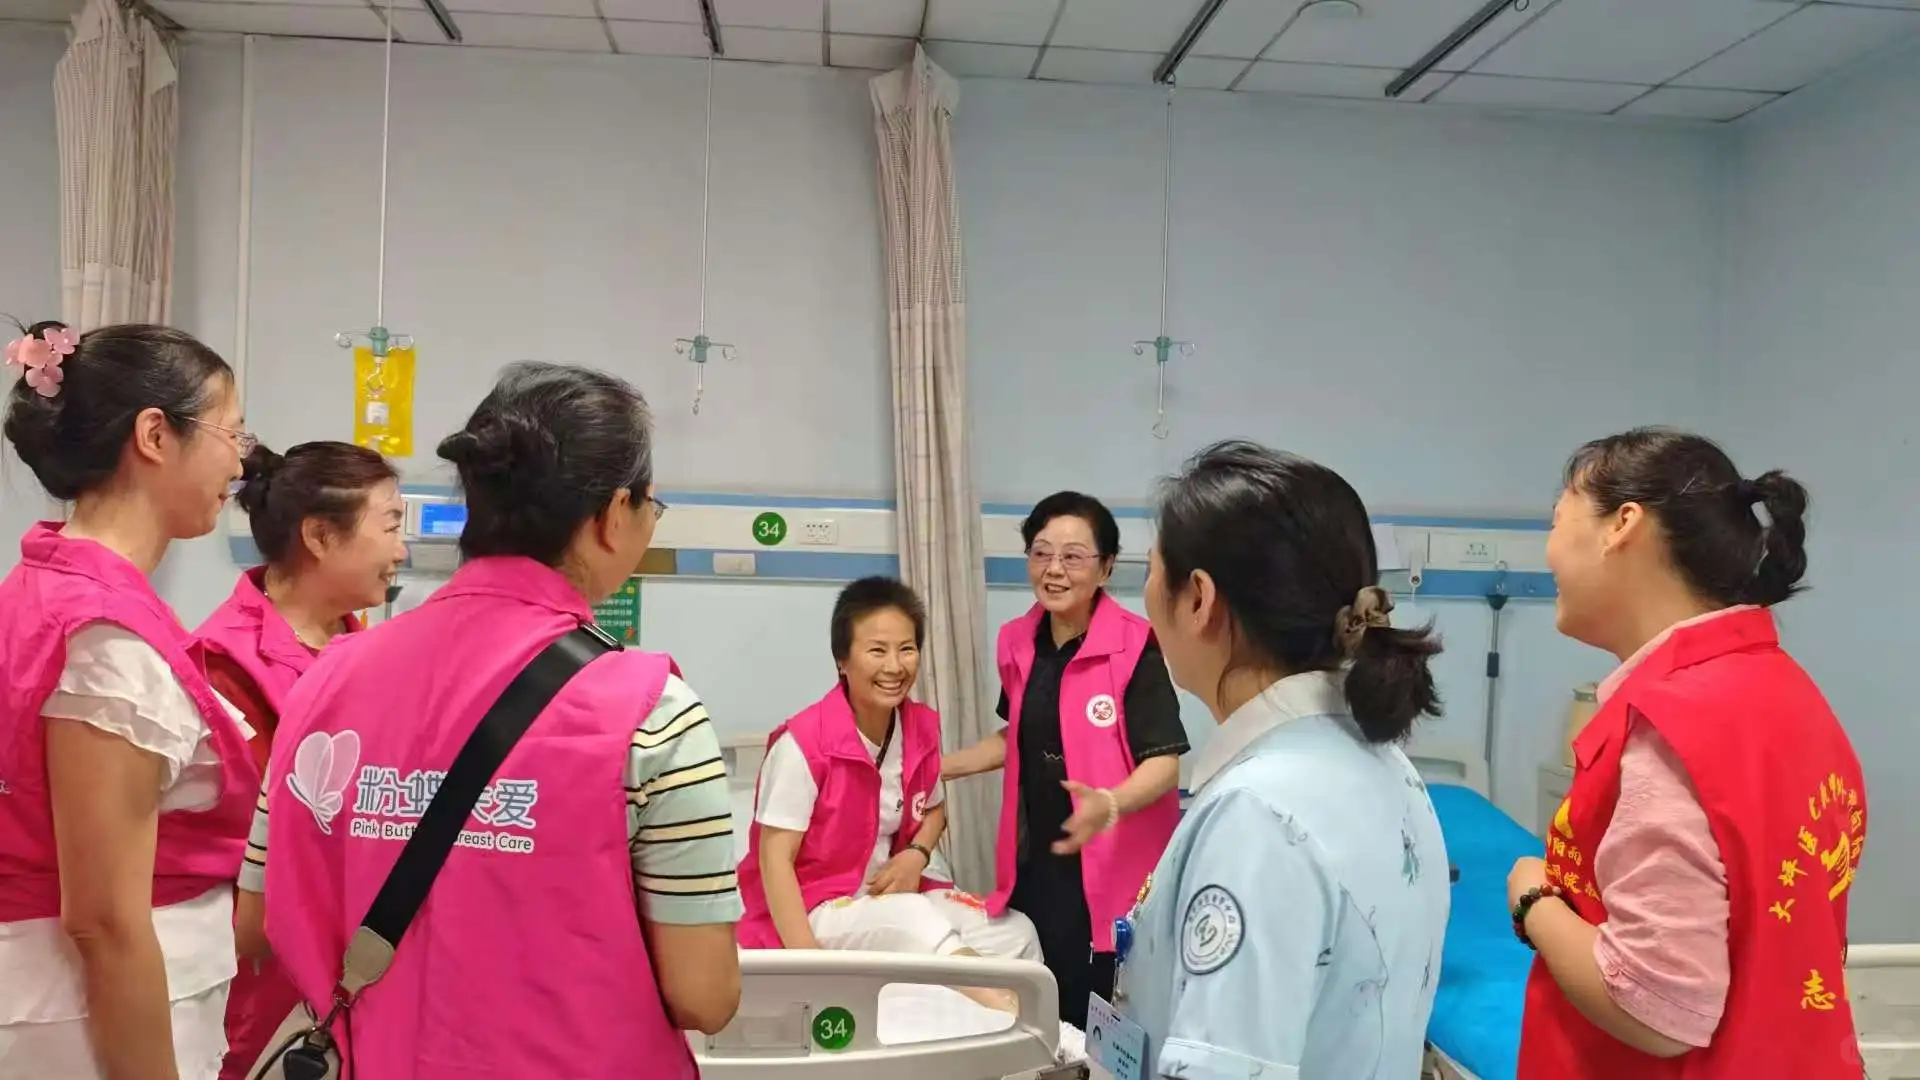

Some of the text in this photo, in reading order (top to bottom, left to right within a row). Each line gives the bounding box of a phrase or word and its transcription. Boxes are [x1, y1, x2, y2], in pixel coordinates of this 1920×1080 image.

[758, 521, 780, 538] 34
[352, 821, 377, 836] Pink
[458, 832, 492, 847] reast
[499, 835, 532, 850] Care
[820, 1017, 848, 1040] 34
